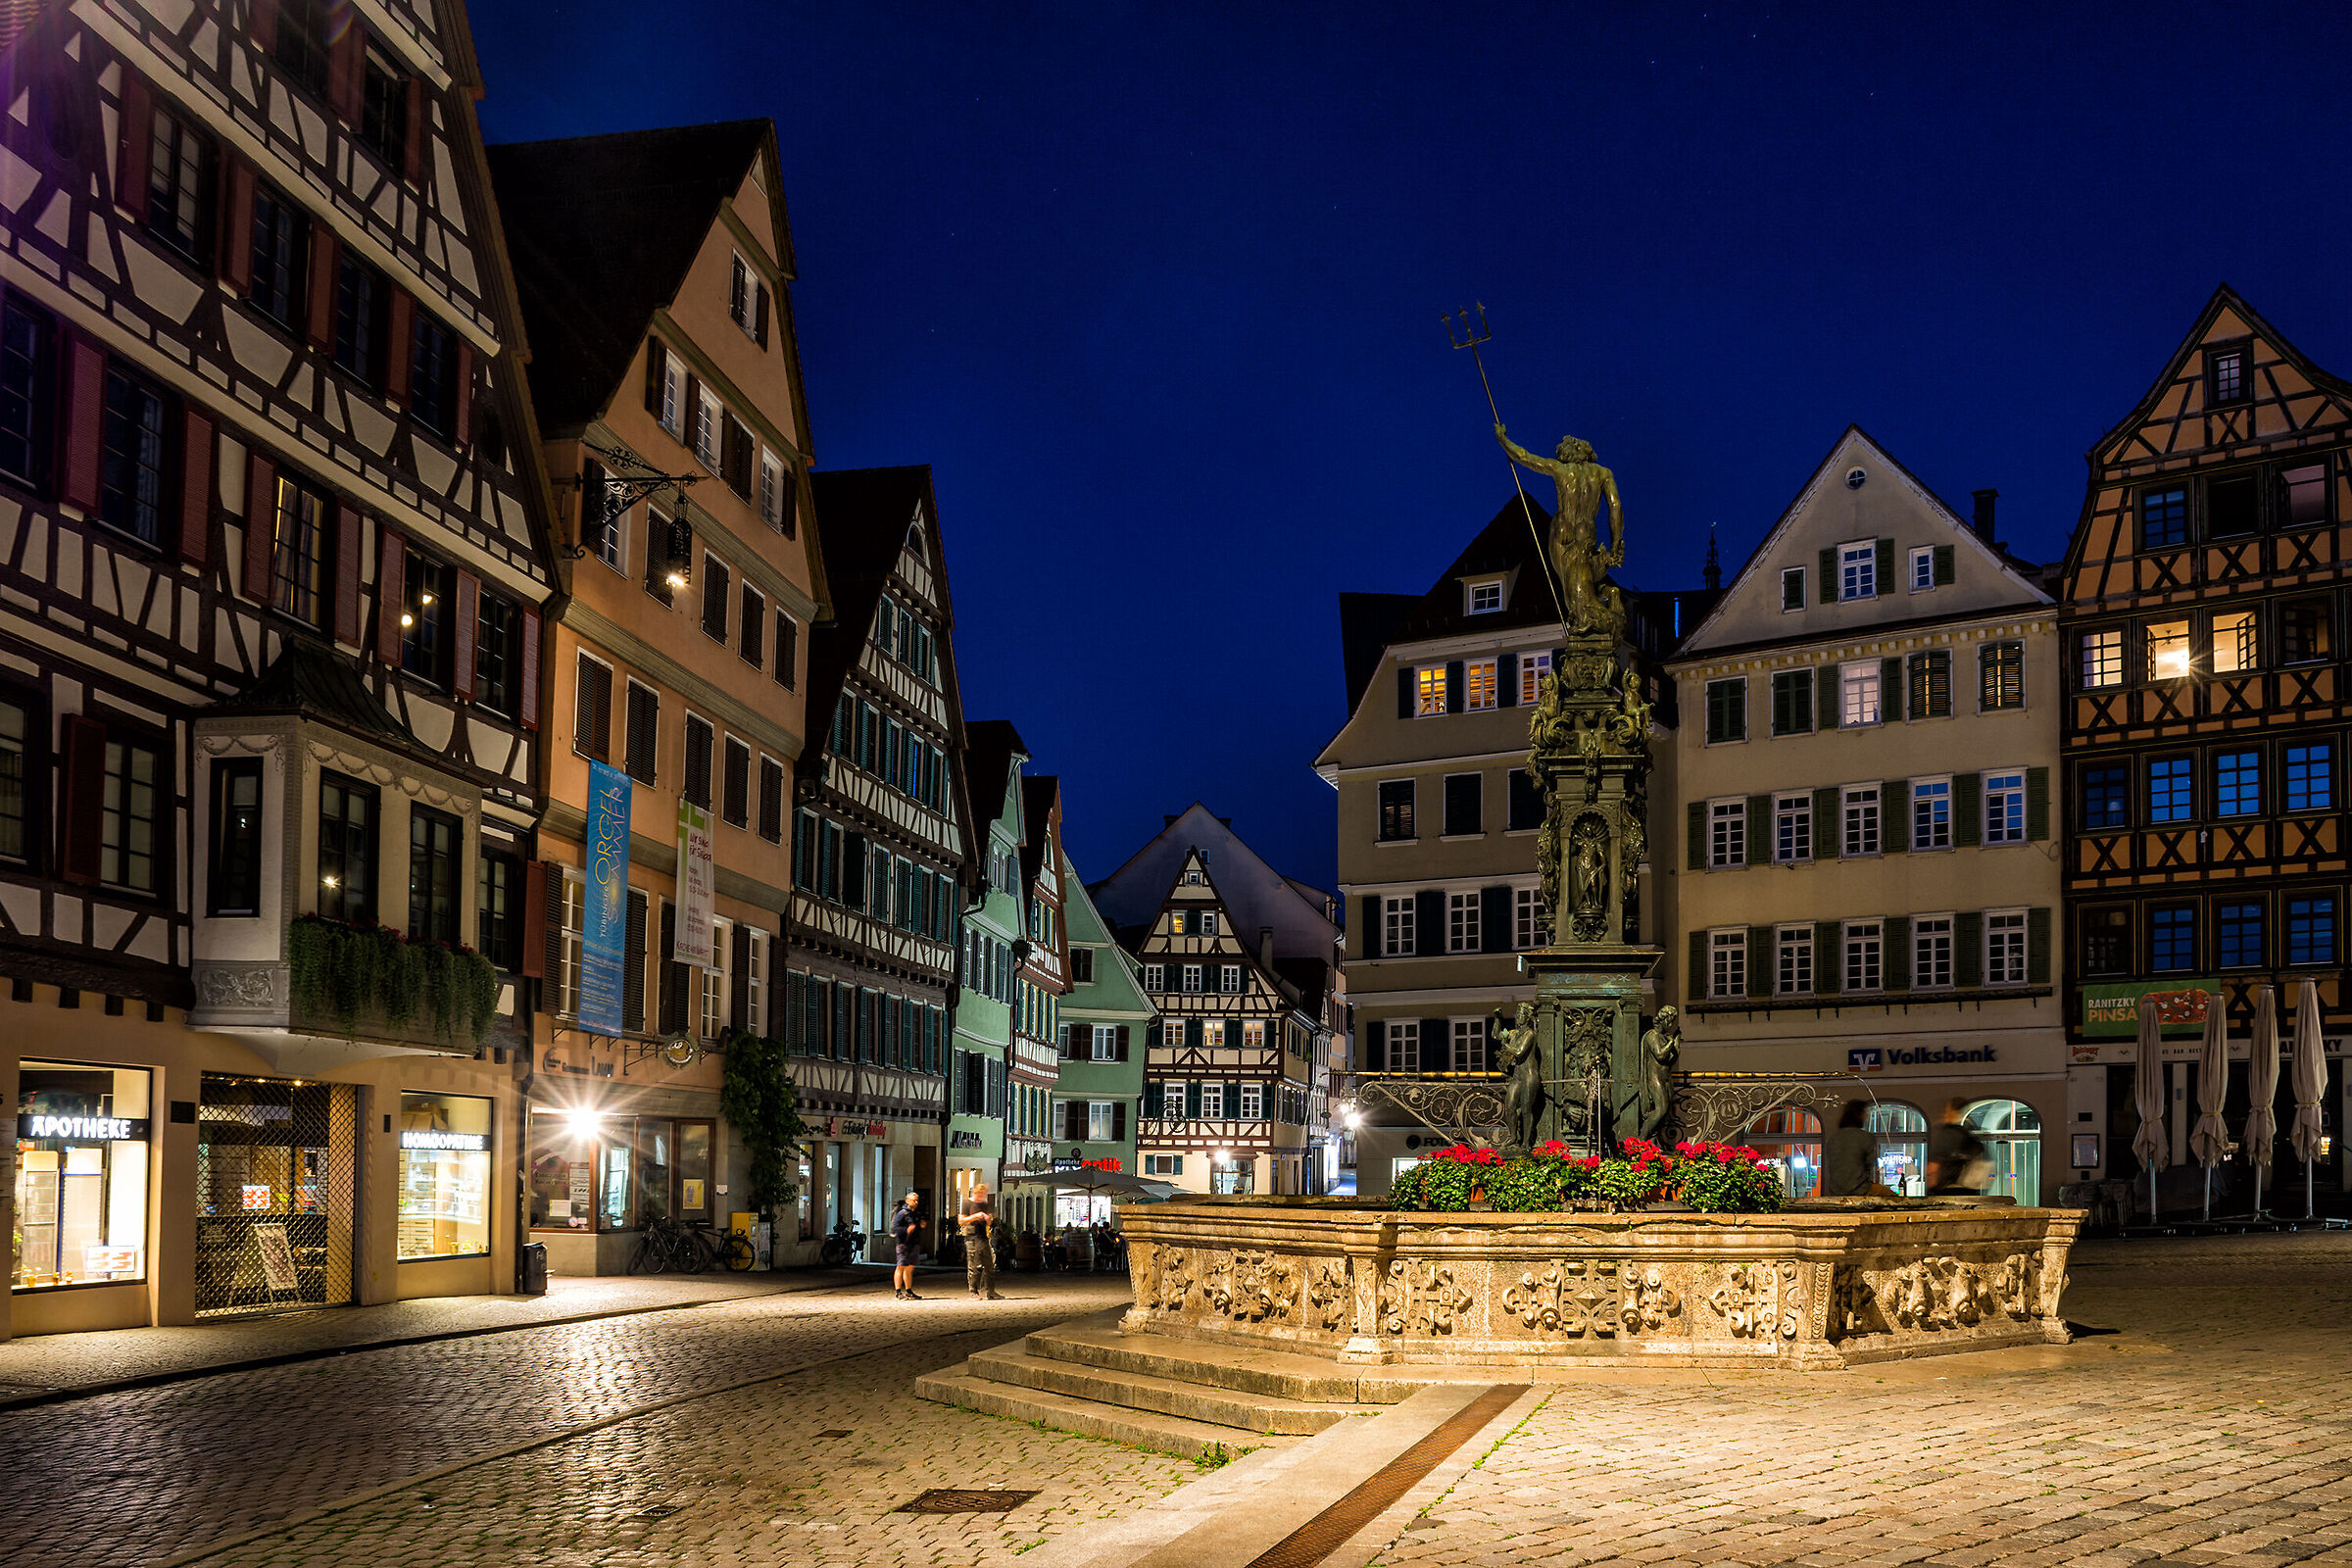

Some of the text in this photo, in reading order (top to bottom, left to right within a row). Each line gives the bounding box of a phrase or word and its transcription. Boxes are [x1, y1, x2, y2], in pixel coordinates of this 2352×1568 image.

[595, 788, 614, 885] ORGEL
[2088, 997, 2135, 1009] RANITZKY
[2088, 1007, 2138, 1022] PINSA
[1887, 1045, 1997, 1064] Volksbank
[30, 1115, 132, 1139] APOTHEKE
[1054, 1158, 1080, 1170] Apotheke
